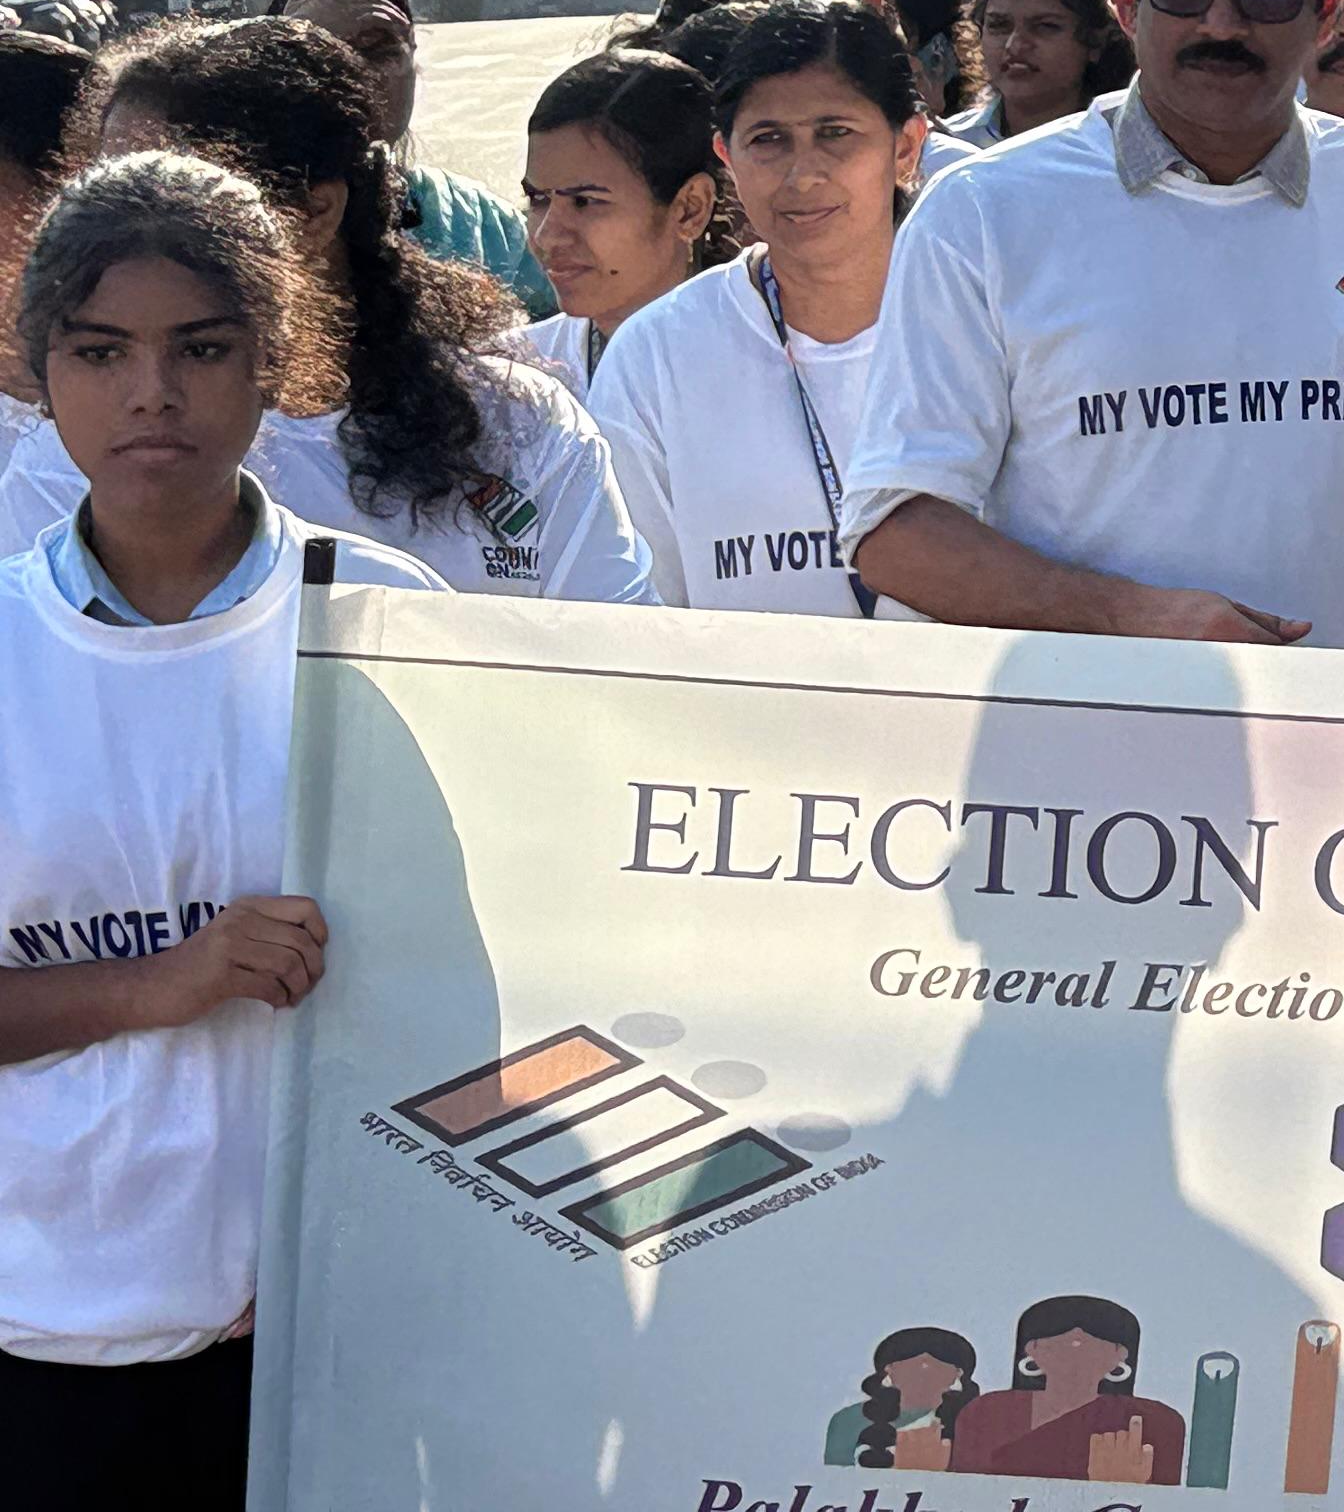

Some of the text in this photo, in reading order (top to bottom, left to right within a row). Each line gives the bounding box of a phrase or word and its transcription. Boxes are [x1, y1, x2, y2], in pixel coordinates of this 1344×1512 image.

[1078, 390, 1127, 436] MY
[1138, 382, 1228, 428] VOTE
[1240, 380, 1290, 422] MY
[714, 531, 845, 579] MY VOTE
[620, 782, 1279, 913] ELECTION
[70, 910, 170, 960] VOTE
[869, 948, 1117, 1011] General
[360, 1111, 424, 1155] भारत
[512, 1210, 598, 1263] आयोग
[630, 1226, 716, 1268] ELECTION
[811, 1171, 838, 1192] OF
